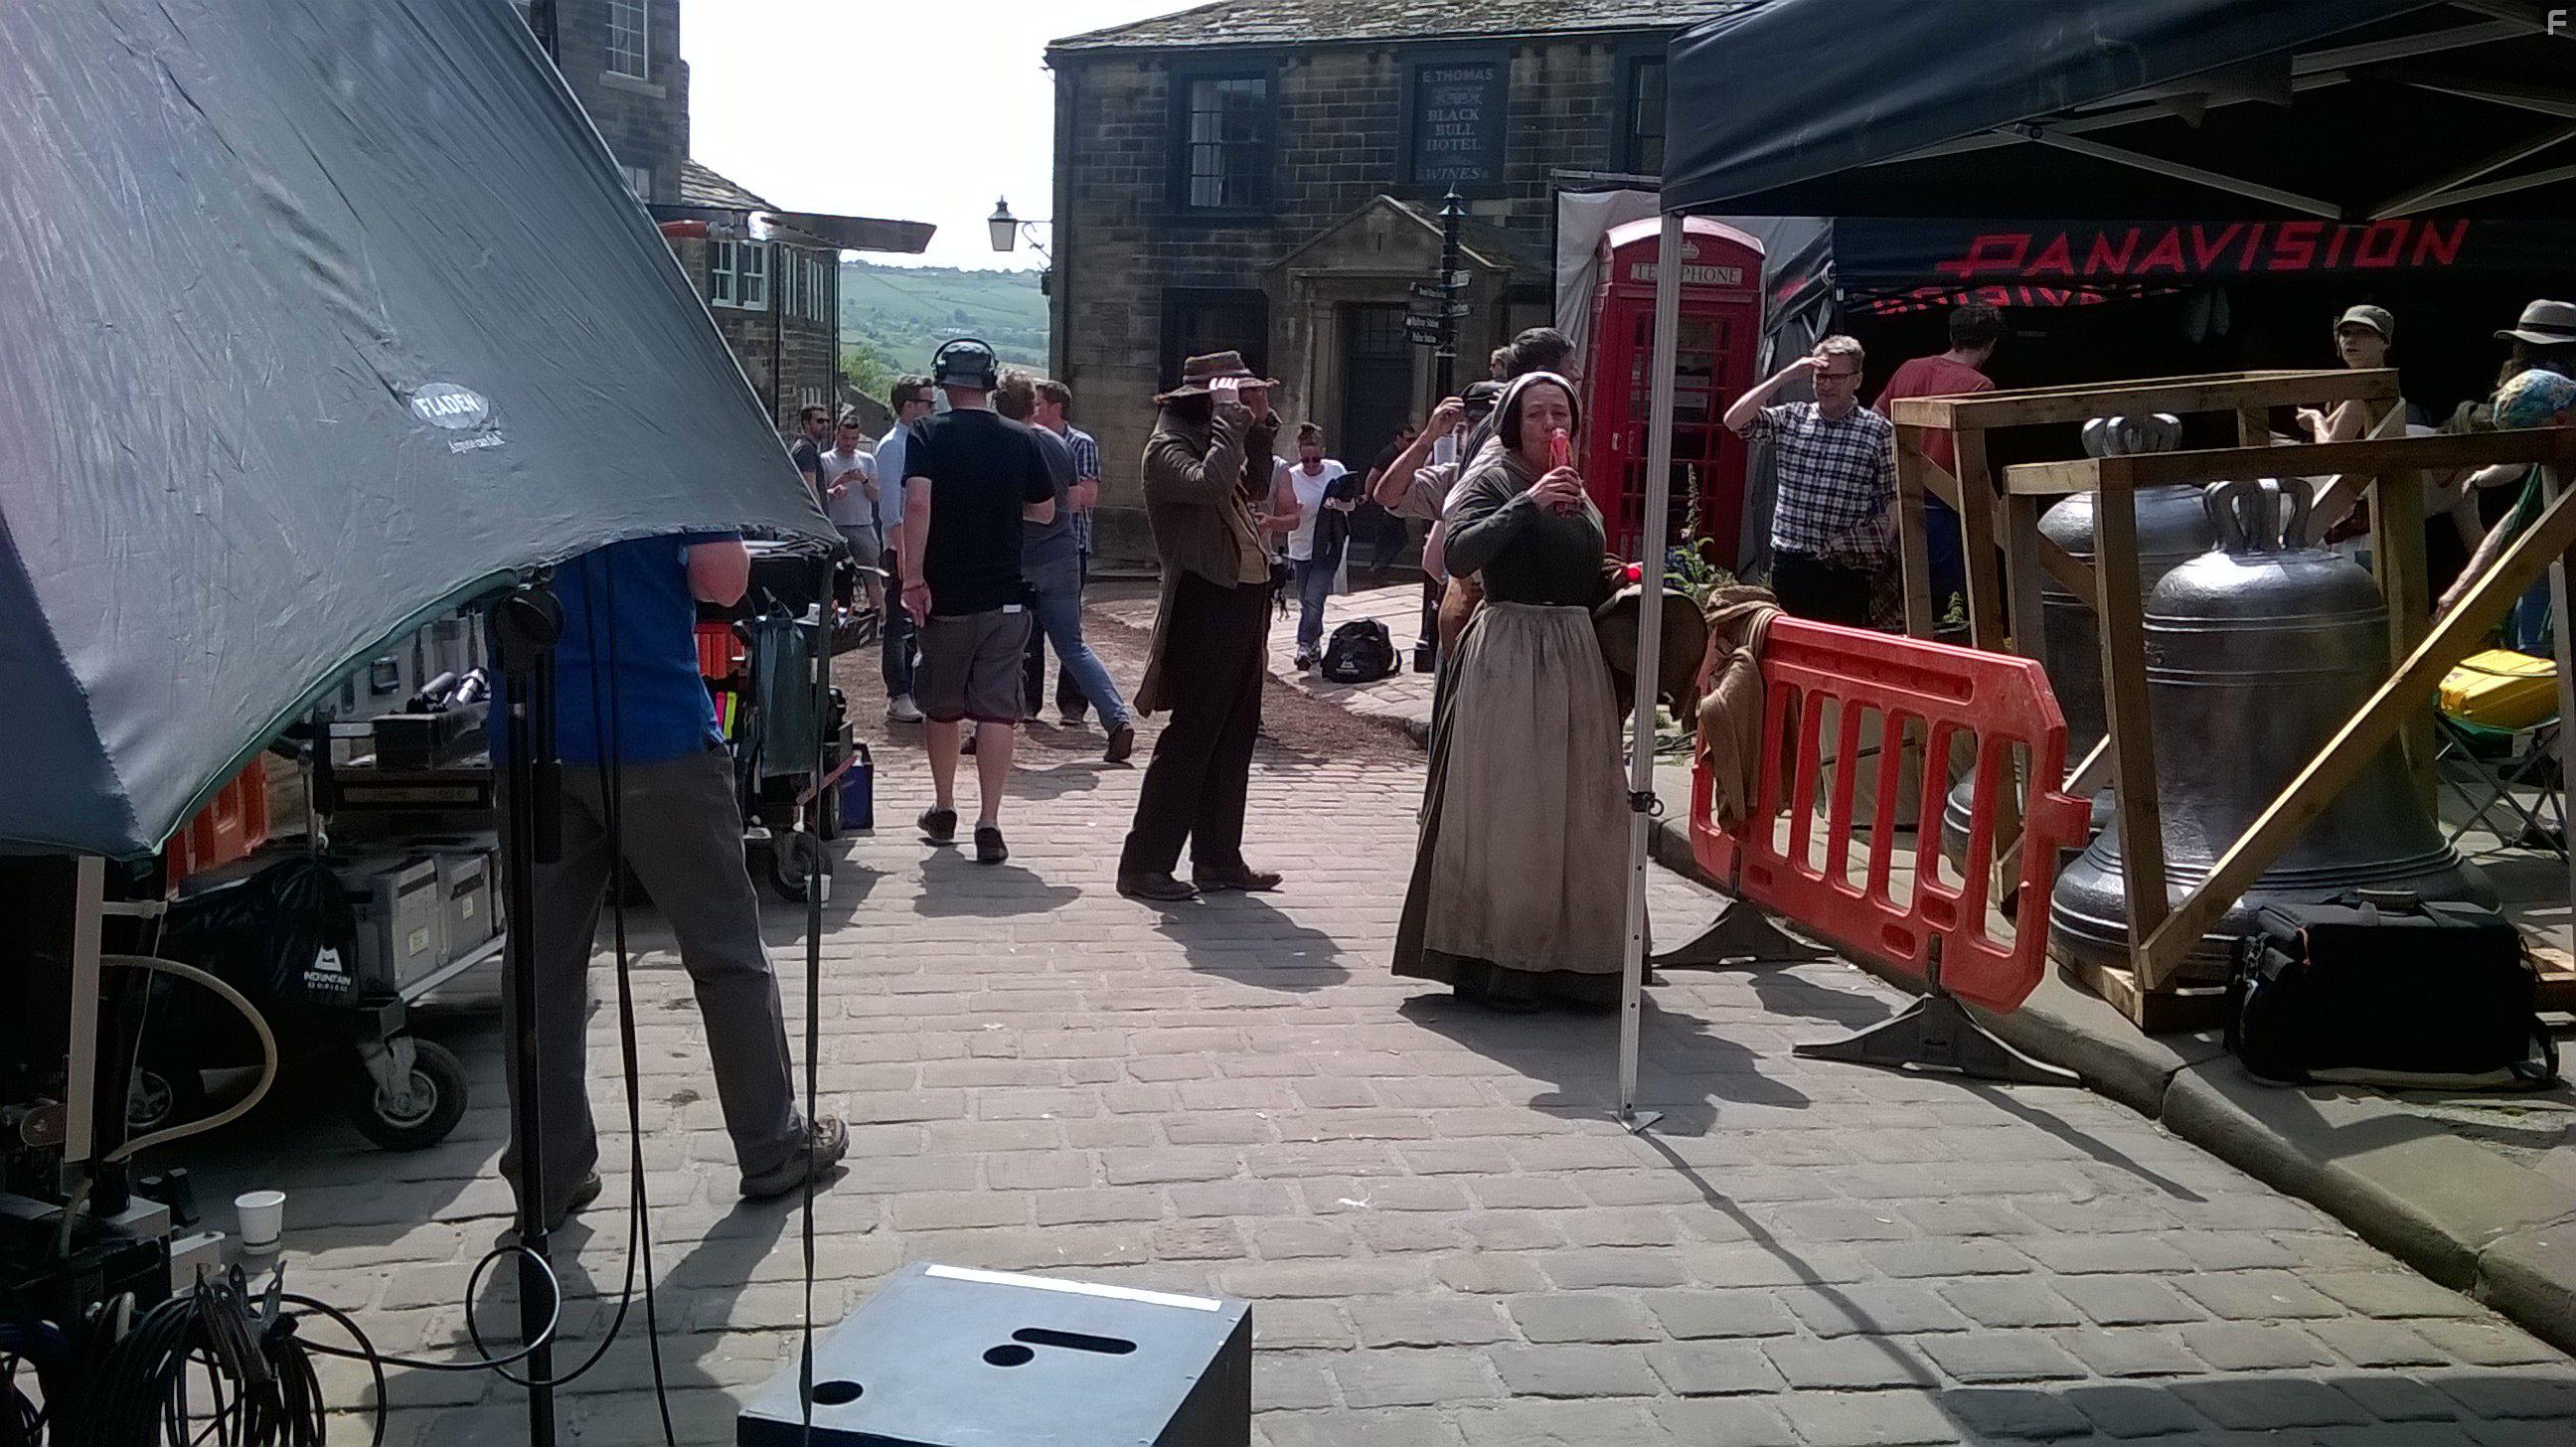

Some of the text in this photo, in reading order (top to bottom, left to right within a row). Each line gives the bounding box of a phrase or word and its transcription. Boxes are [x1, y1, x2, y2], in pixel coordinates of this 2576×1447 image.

[1435, 69, 1494, 81] THOMAS
[1426, 108, 1480, 121] BLACK
[1435, 123, 1475, 136] BULL
[1426, 139, 1482, 151] HOTEL
[1426, 167, 1481, 180] WINES
[1934, 218, 2471, 279] PANAVISION
[1637, 263, 1739, 284] TEPHONE
[414, 393, 482, 418] FLADEN
